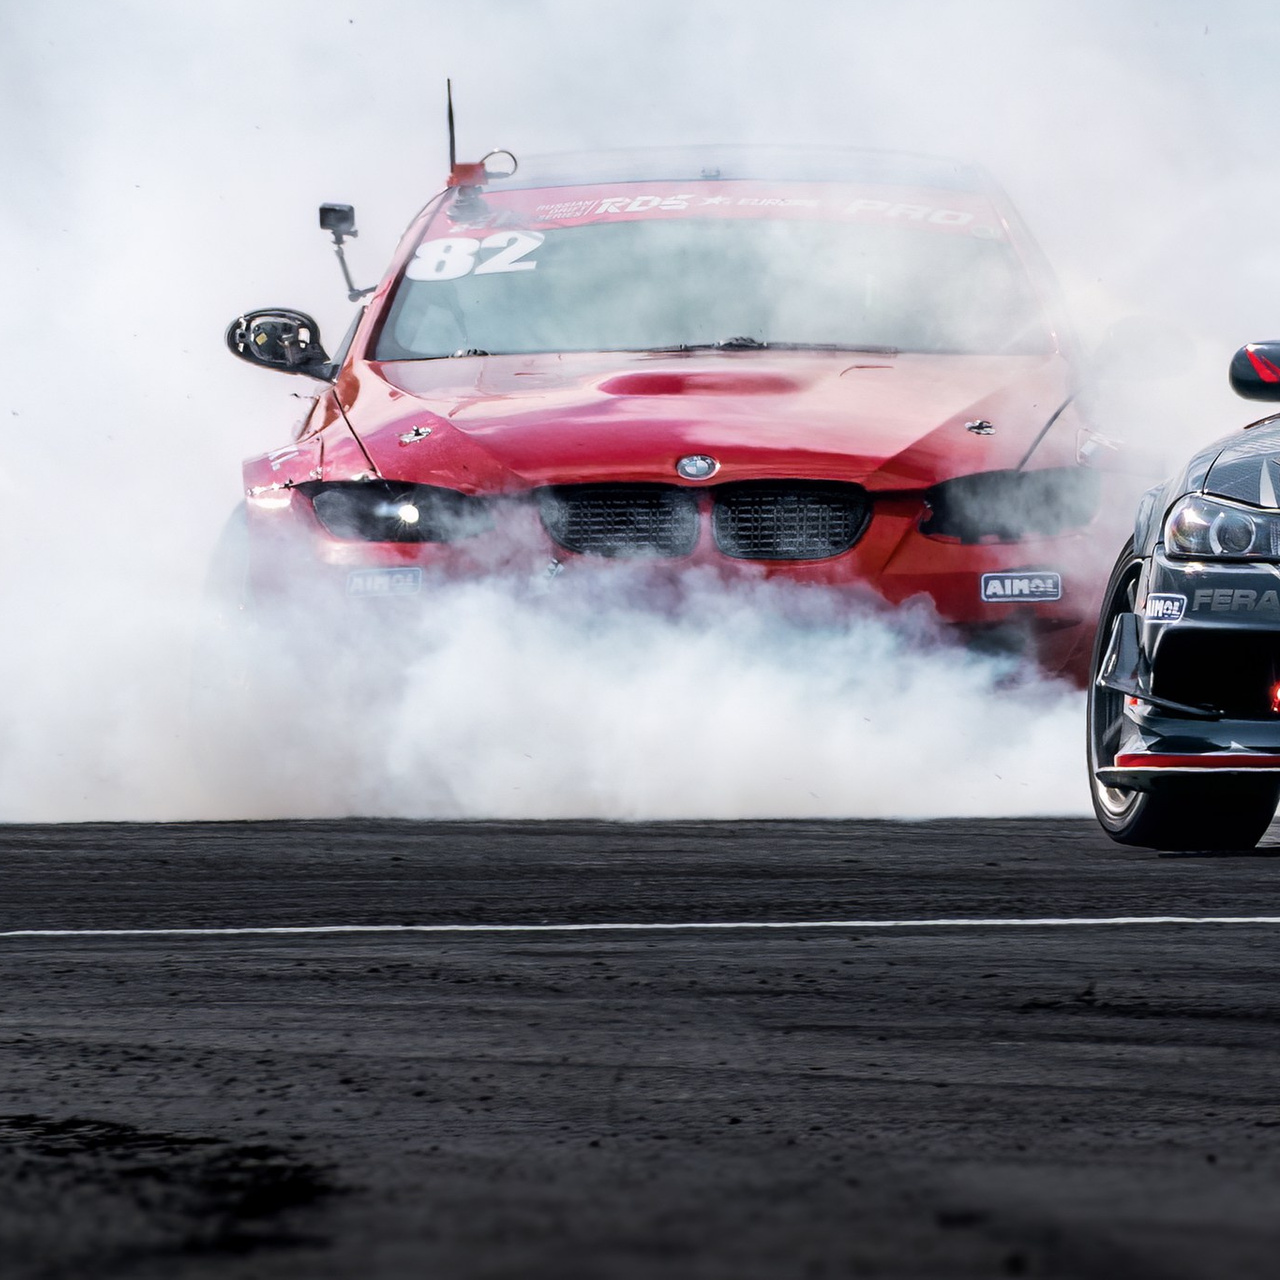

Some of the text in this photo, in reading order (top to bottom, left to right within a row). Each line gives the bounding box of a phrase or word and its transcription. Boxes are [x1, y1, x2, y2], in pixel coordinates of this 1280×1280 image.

[594, 194, 696, 214] RDS
[847, 199, 975, 225] PRO
[404, 230, 546, 282] 82
[986, 578, 1058, 596] AIMOL
[1192, 589, 1280, 611] FERA
